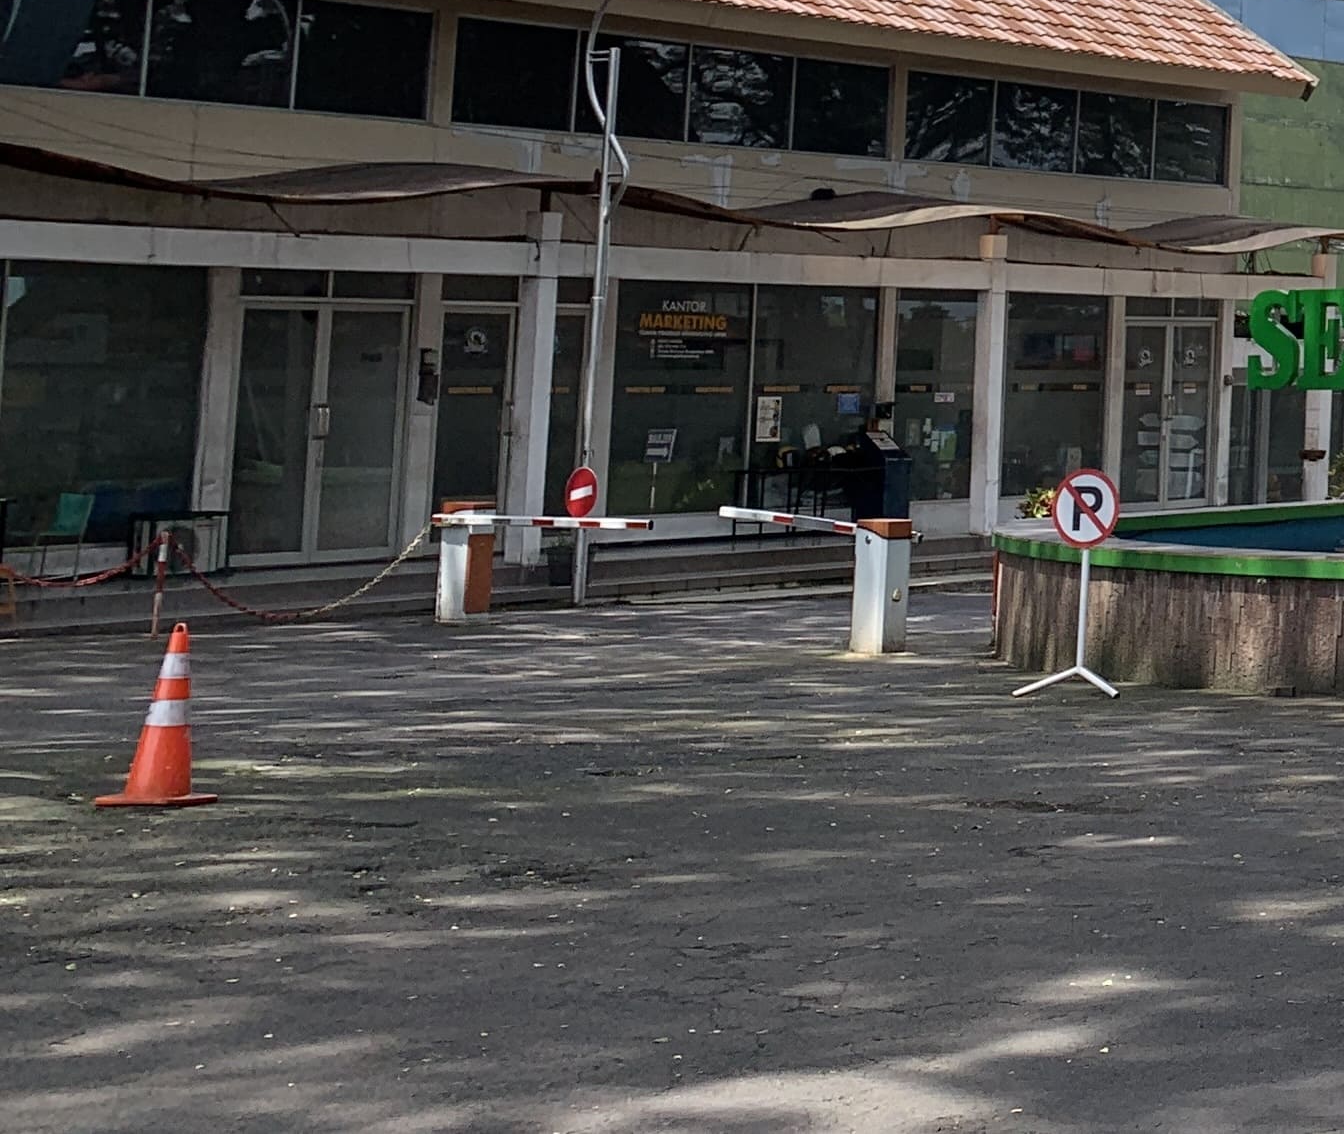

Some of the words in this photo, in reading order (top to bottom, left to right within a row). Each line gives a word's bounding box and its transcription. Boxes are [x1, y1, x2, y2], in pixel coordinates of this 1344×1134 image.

[662, 300, 708, 313] KANTOR
[639, 313, 728, 331] MARKETING
[1072, 486, 1103, 532] P
